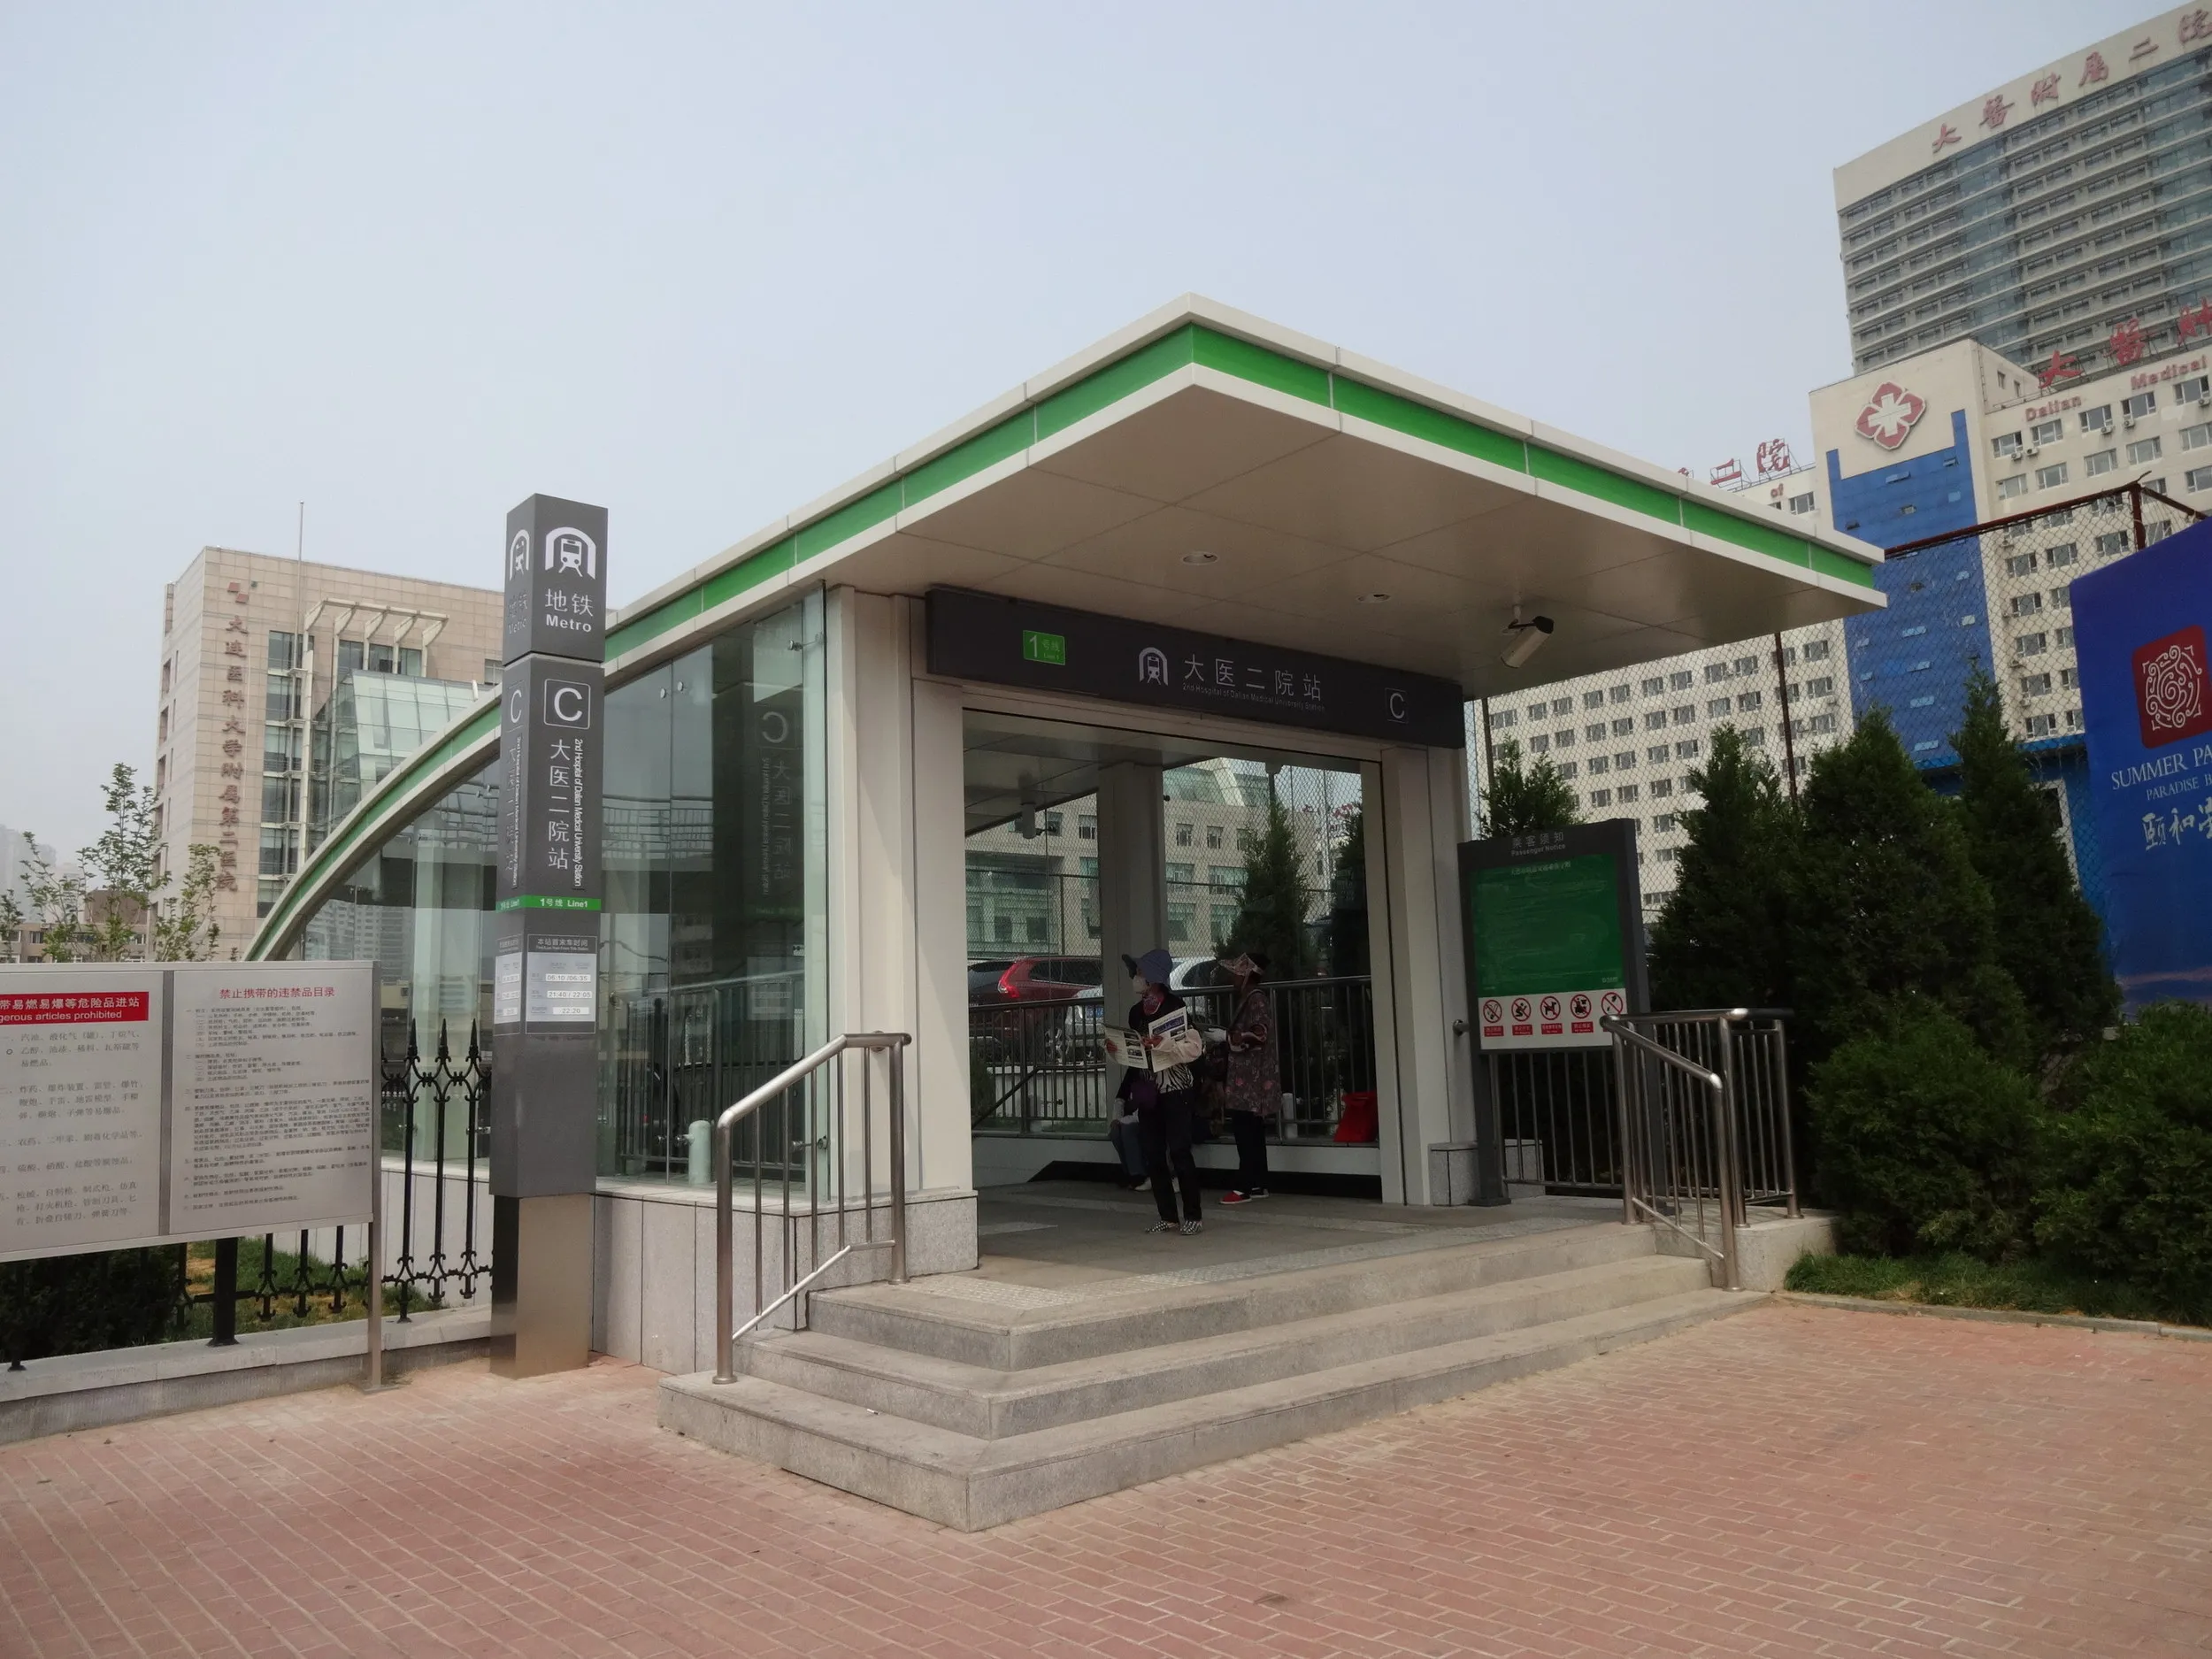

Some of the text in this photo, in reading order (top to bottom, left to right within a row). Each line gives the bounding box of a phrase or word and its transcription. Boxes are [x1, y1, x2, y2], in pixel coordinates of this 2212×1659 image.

[2025, 355, 2208, 422] Dalian Medical
[1770, 483, 1784, 498] of
[545, 588, 594, 617] 地铁
[546, 614, 592, 633] Metro
[1184, 653, 1321, 701] 大医二院站
[511, 690, 522, 723] C
[554, 687, 582, 722] C
[1389, 693, 1405, 718] C
[574, 738, 583, 752] 2nd
[573, 752, 583, 778] Hospital
[2111, 744, 2212, 790] SUMMER PA
[574, 786, 583, 806] Dalian
[2146, 777, 2200, 801] PARADISE
[549, 739, 571, 870] 大医二院站
[574, 807, 583, 832] Medical
[572, 833, 583, 864] University
[1545, 843, 1566, 853] Notice
[574, 864, 583, 887] Station
[540, 898, 588, 908] 1号线 Line1
[219, 987, 335, 1000] 禁止携带的违禁品目录
[35, 1011, 71, 1021] articles
[74, 1010, 122, 1022] prohibited
